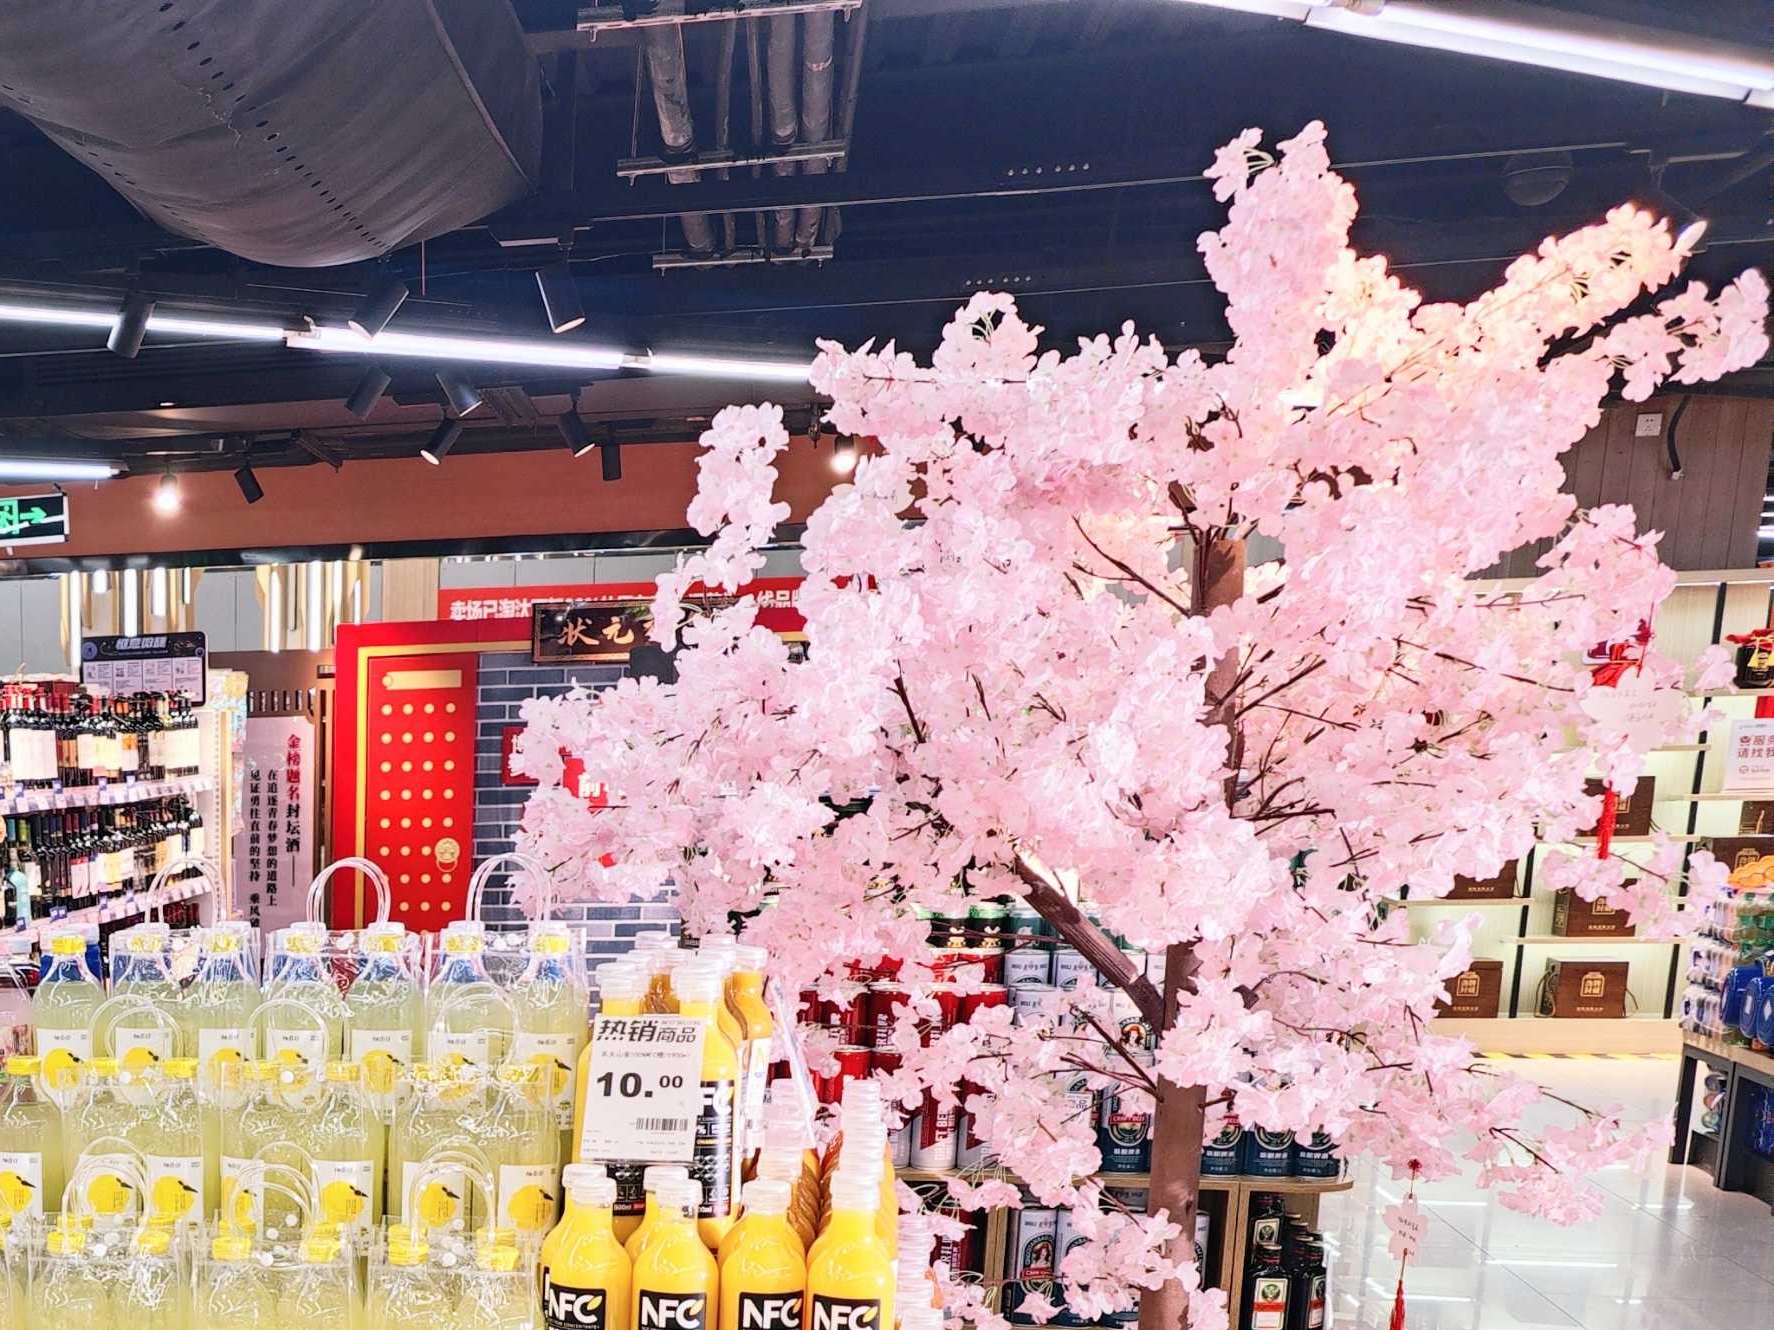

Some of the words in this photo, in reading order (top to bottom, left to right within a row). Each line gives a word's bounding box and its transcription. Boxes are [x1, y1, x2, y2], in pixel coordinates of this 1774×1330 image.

[597, 1020, 697, 1043] 热销商品
[597, 1071, 683, 1098] 10.00
[548, 1297, 598, 1326] NFC
[641, 1297, 701, 1329] NFC
[743, 1299, 800, 1330] NFC
